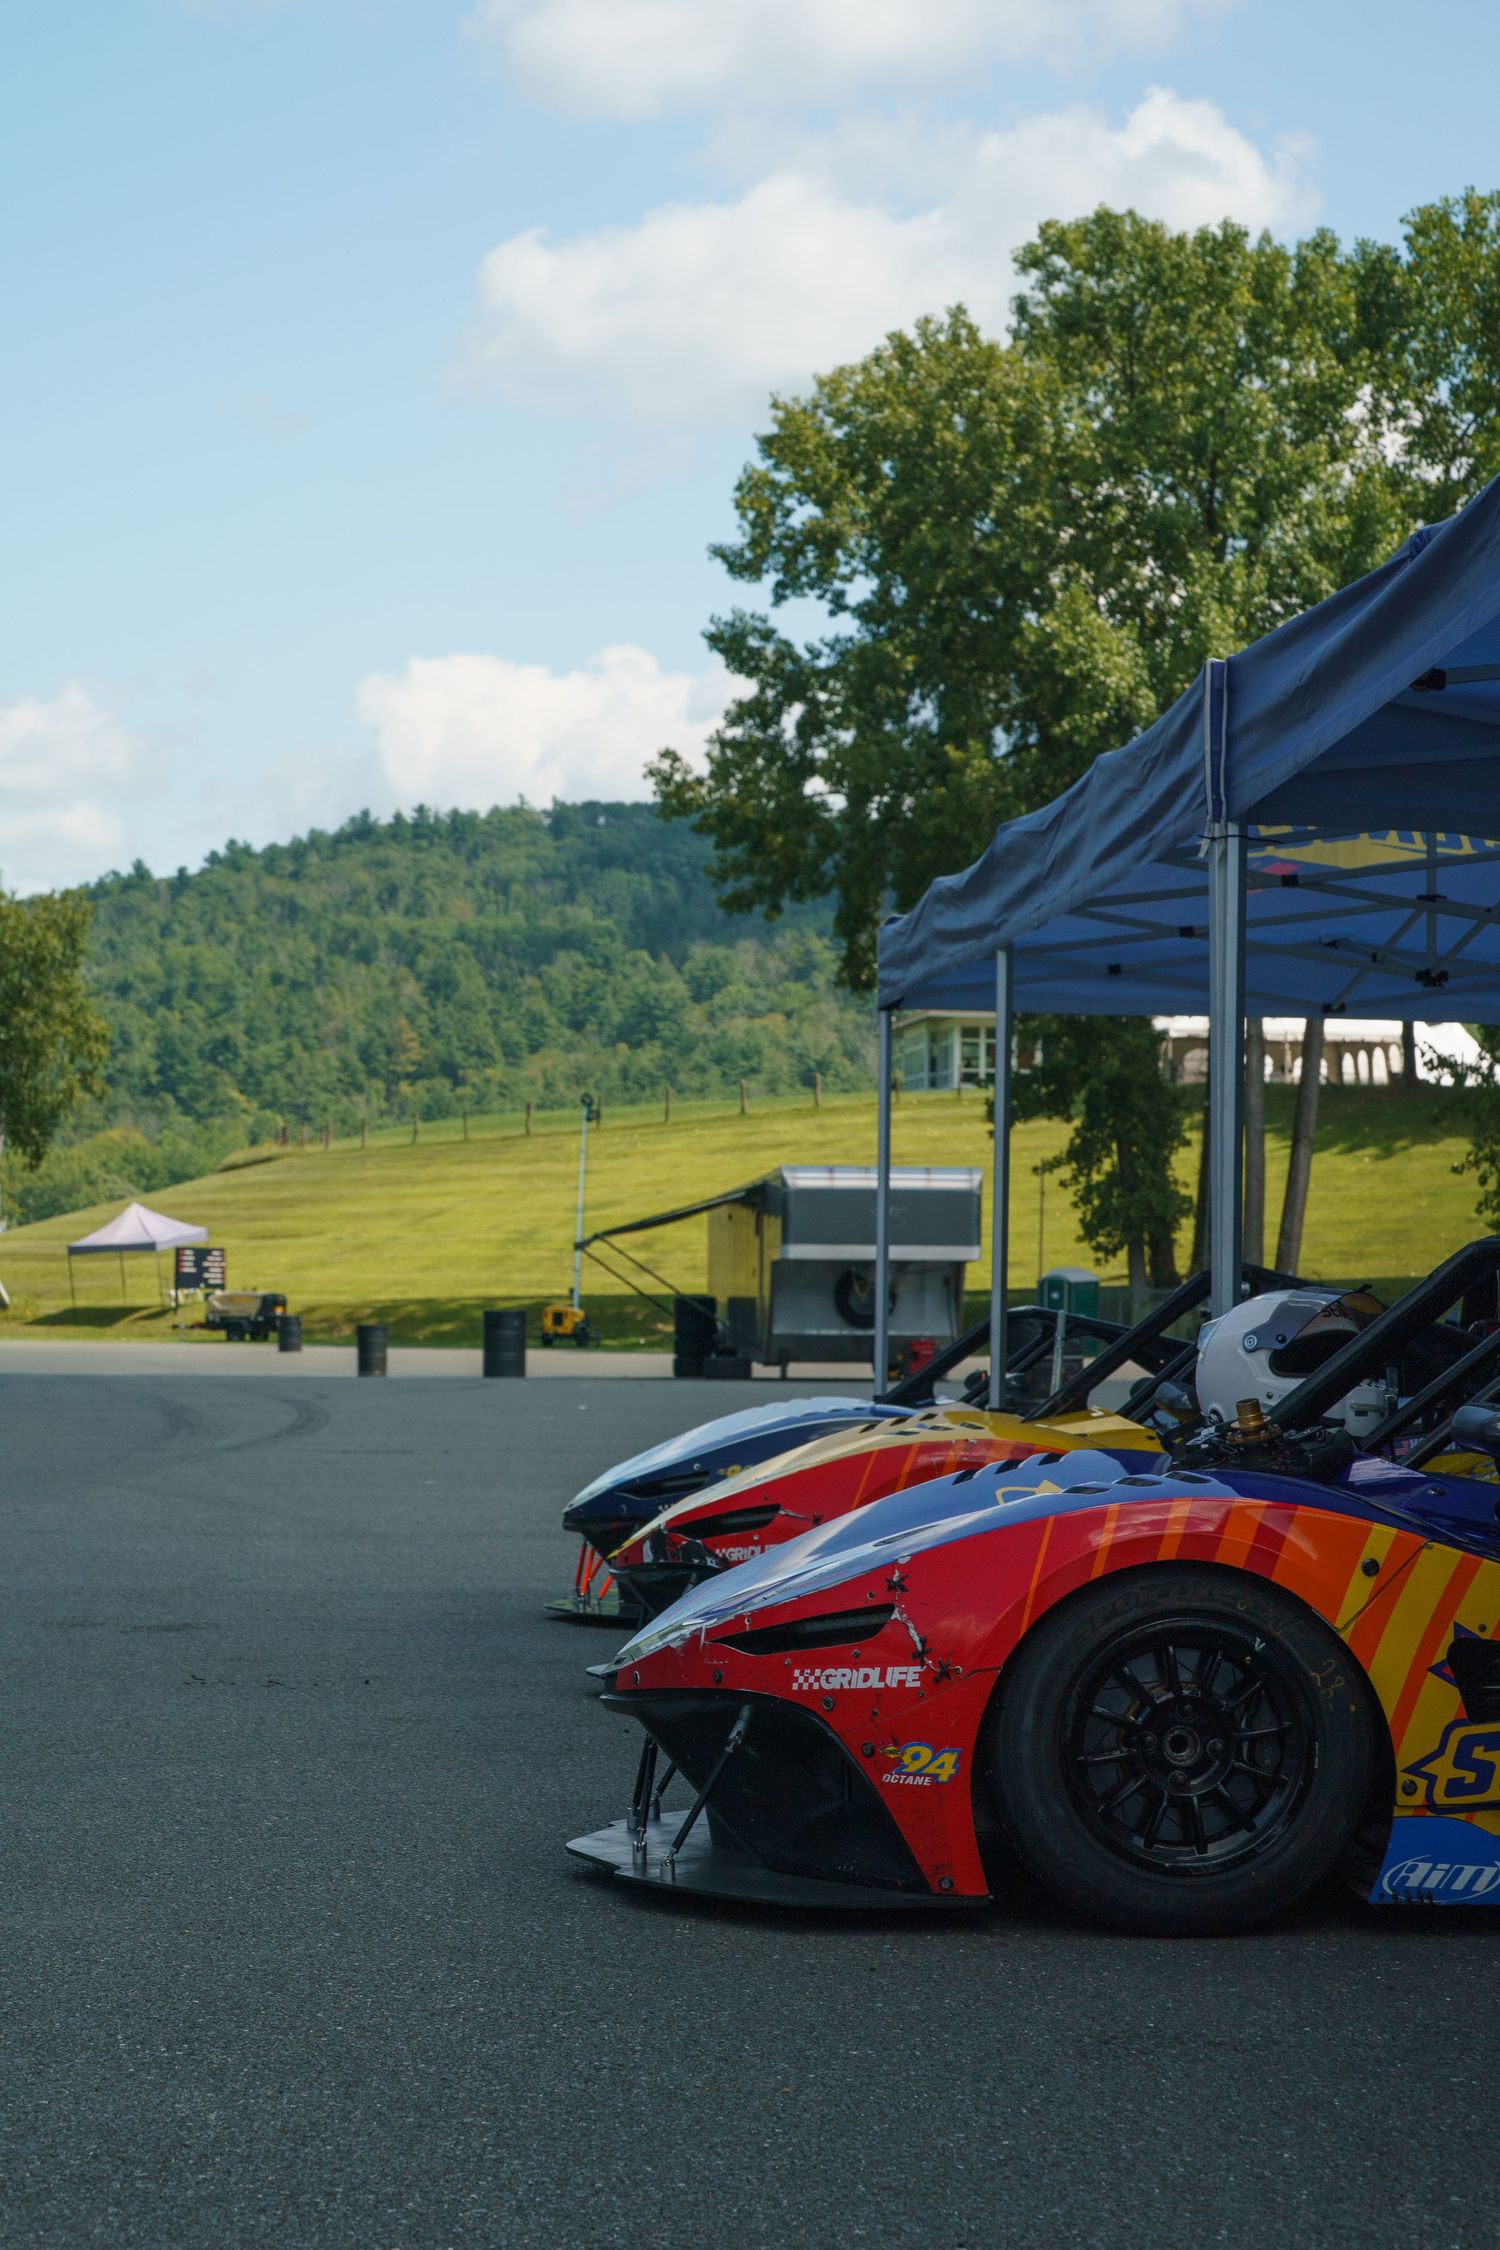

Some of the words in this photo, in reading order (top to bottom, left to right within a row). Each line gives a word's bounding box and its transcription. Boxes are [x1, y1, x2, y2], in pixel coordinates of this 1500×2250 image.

[820, 1665, 922, 1690] GRIDLIFE
[899, 1743, 961, 1783] 94
[882, 1773, 932, 1786] OCTANE
